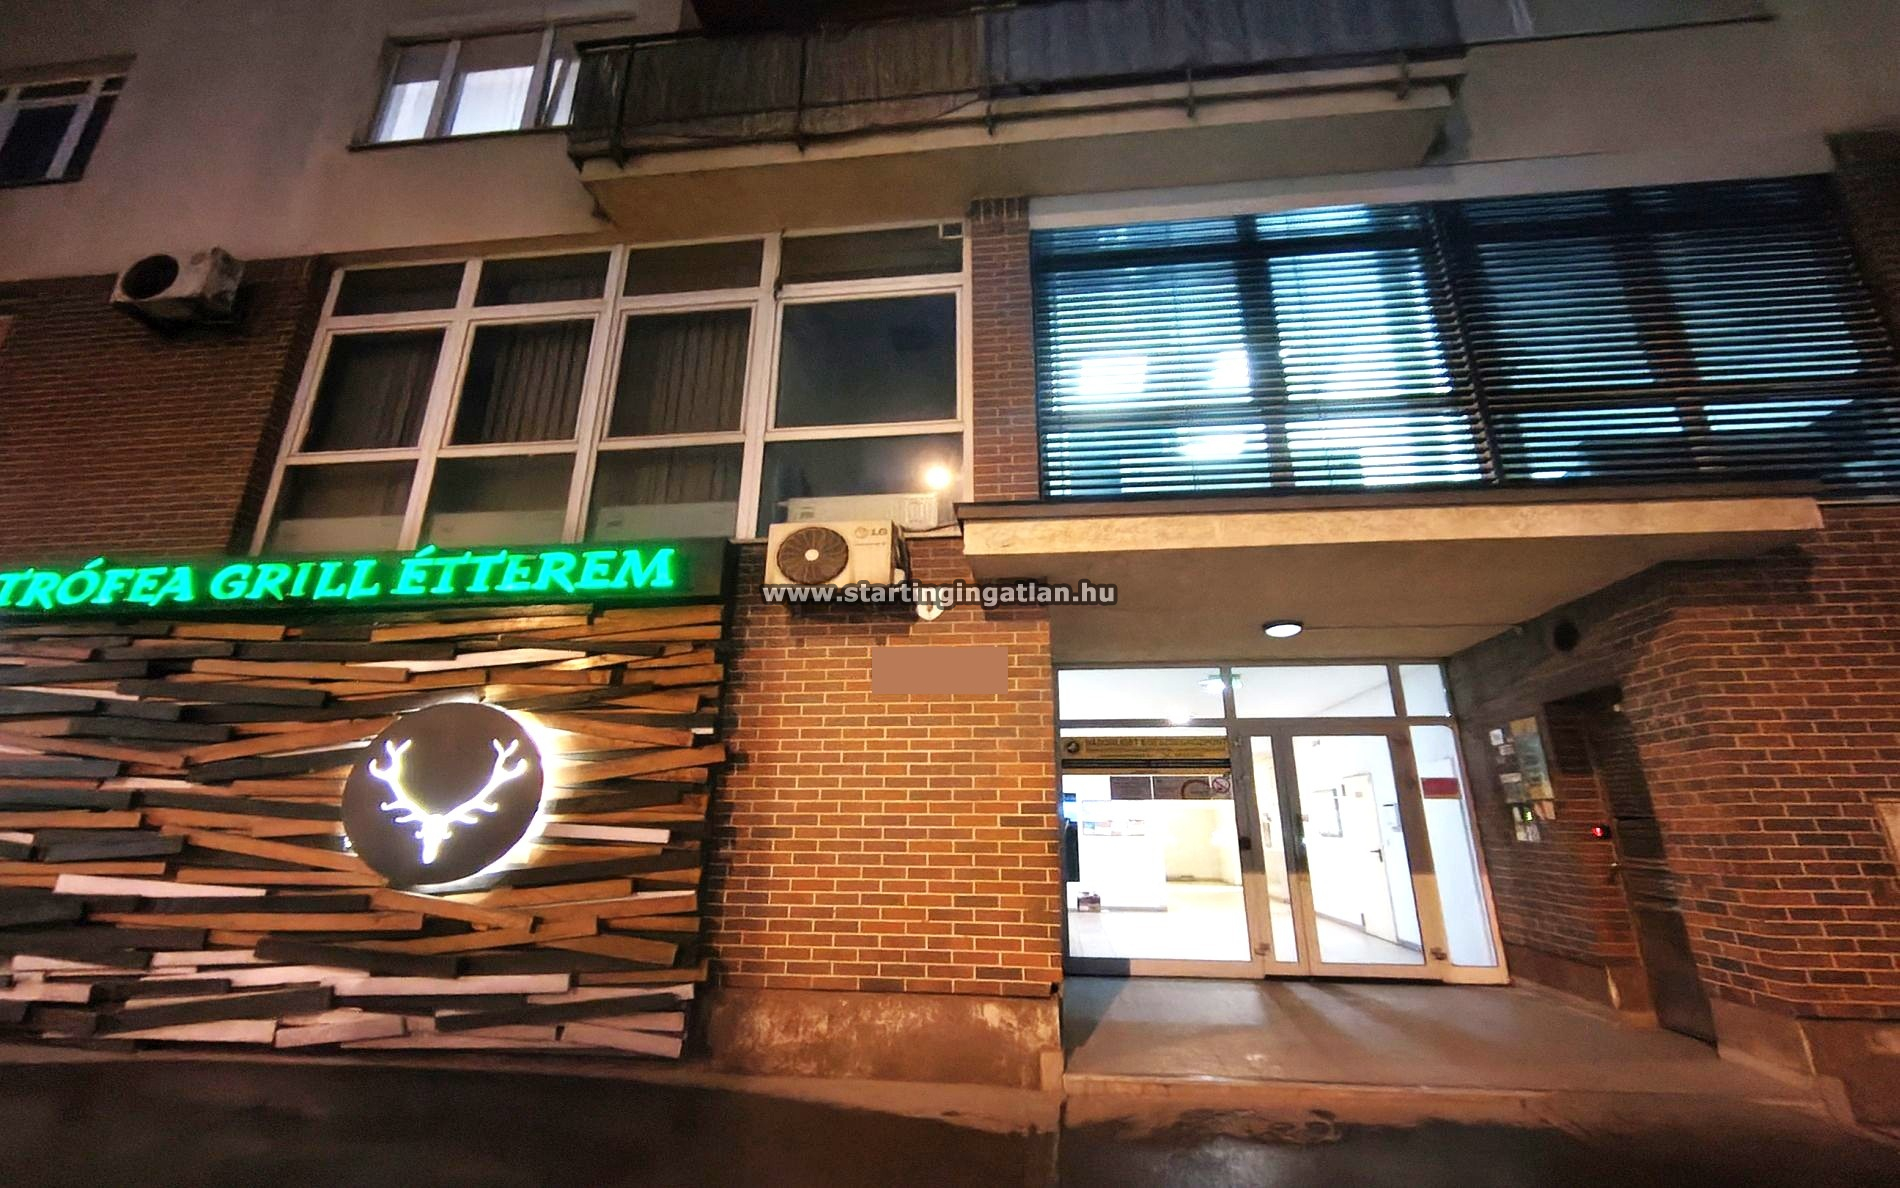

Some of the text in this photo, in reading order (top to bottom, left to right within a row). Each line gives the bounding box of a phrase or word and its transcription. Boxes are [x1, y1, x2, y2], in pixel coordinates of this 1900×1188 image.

[871, 527, 888, 536] LG
[0, 544, 676, 609] TRÓFEA GRILL ÉTTEREM
